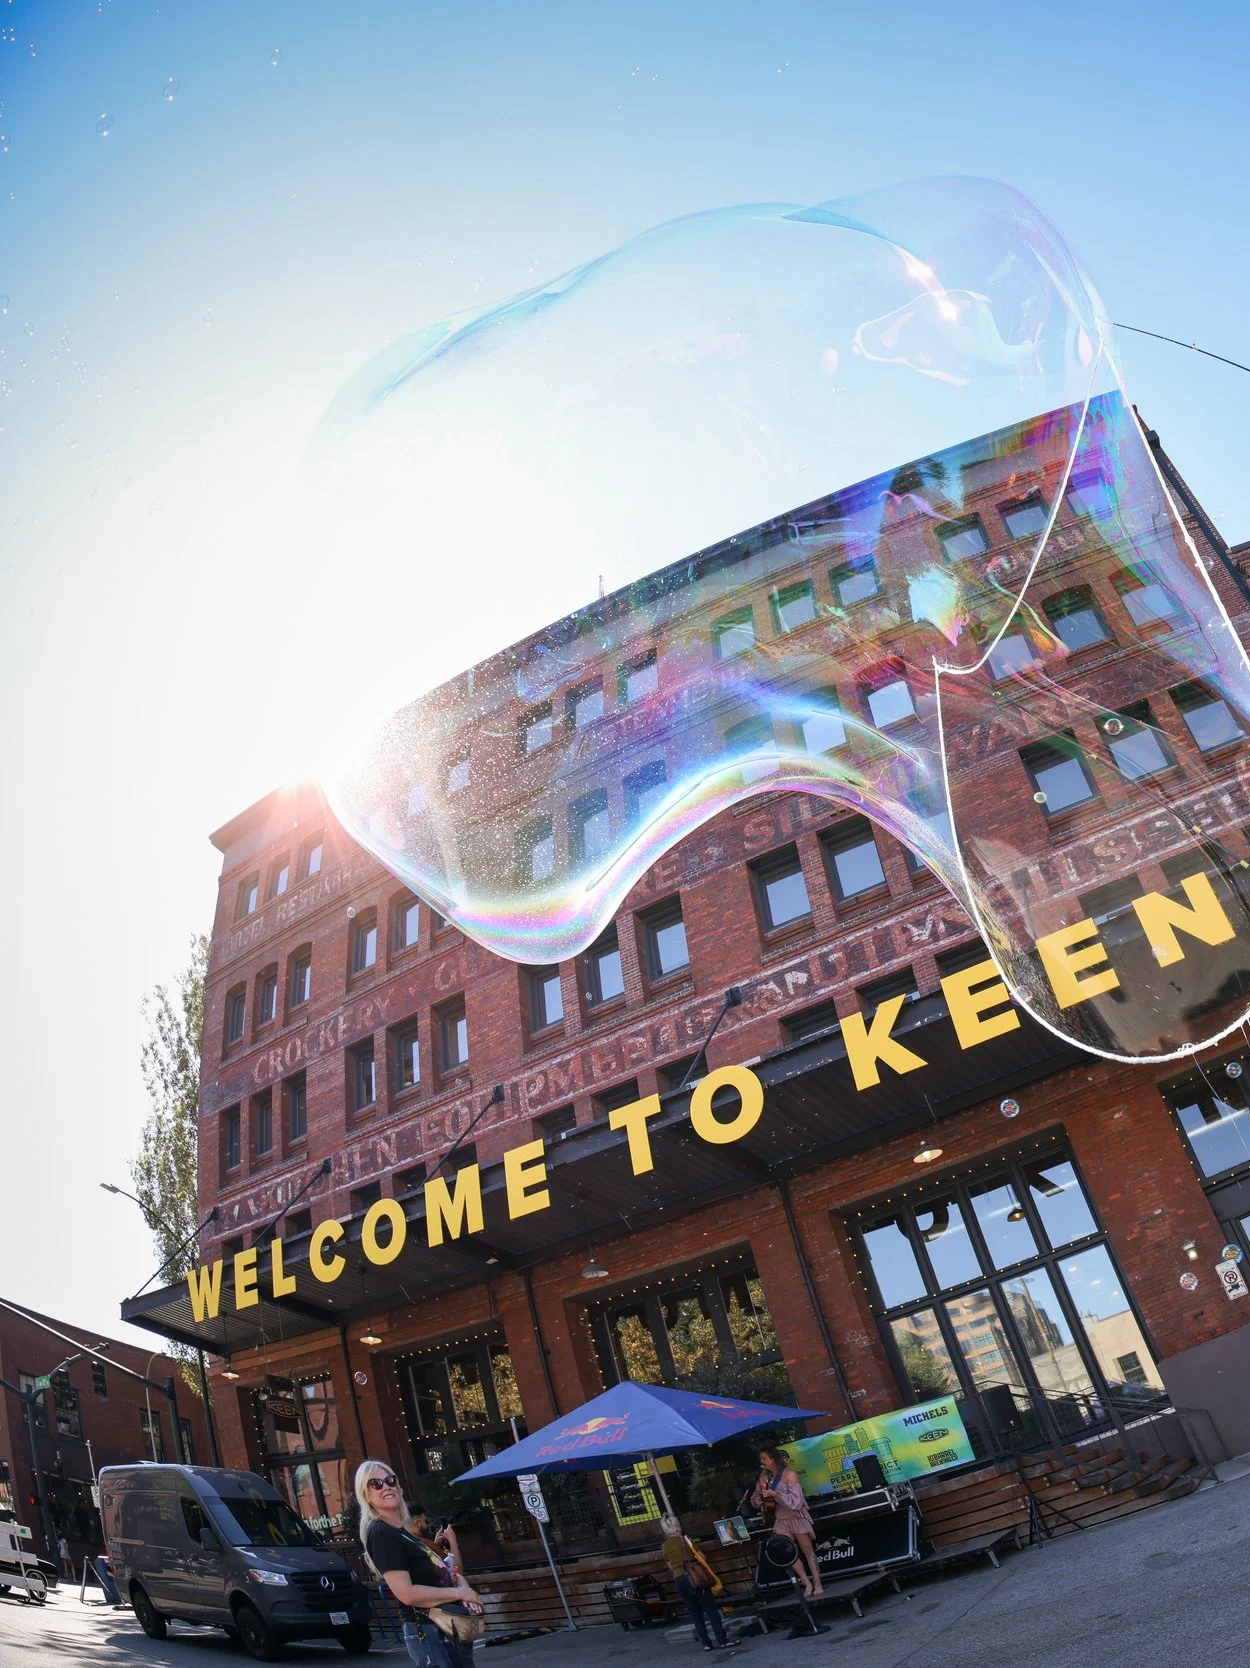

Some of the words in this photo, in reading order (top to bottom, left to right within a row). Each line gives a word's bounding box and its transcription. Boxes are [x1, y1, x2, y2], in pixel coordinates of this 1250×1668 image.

[252, 987, 396, 1085] CROCKERY
[187, 1140, 550, 1322] WELCOME
[610, 1065, 763, 1175] TO
[841, 872, 1236, 1091] KEEN
[268, 1401, 301, 1417] KEEN
[902, 1405, 949, 1428] MICHELS
[536, 1436, 578, 1458] Red
[577, 1425, 630, 1450] Bull
[919, 1429, 949, 1443] KEEN
[934, 1448, 957, 1461] BARREL
[830, 1472, 858, 1485] PEARL
[816, 1552, 832, 1564] ed
[832, 1545, 855, 1560] Bull
